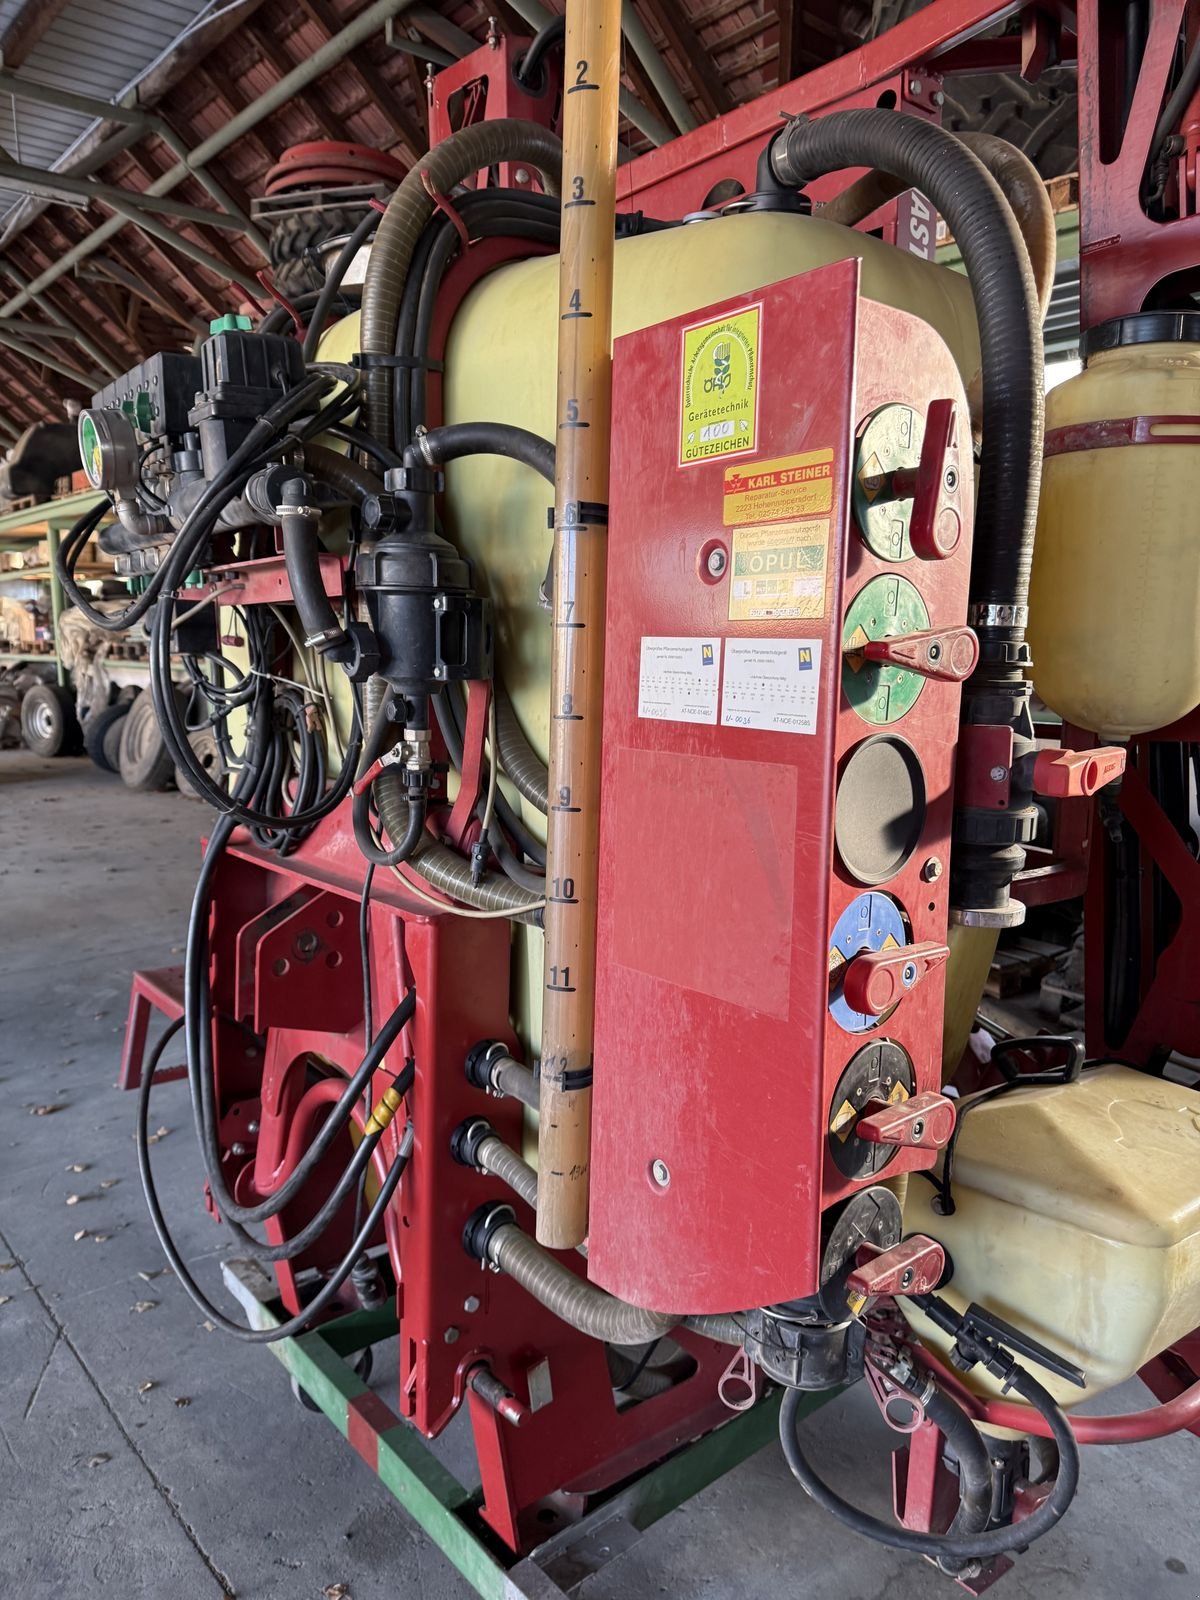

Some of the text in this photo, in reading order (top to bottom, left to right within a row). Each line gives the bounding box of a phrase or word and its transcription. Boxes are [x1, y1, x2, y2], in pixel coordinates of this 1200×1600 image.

[576, 61, 588, 84] 2
[572, 177, 584, 200] 3
[569, 289, 581, 311] 4
[567, 399, 579, 421] 5
[688, 399, 749, 422] Gerätetechnik
[703, 422, 729, 438] 100
[686, 436, 749, 459] GÜTEZEICHEN
[748, 465, 830, 489] KARL STEINER
[745, 487, 807, 501] Reparatur-Service
[565, 503, 577, 525] 6
[736, 504, 752, 513] 2223
[751, 552, 806, 572] ÖPUL
[564, 602, 575, 623] 7
[562, 694, 573, 715] 8
[559, 786, 571, 807] 9
[552, 878, 575, 899] 10
[549, 966, 570, 987] 11
